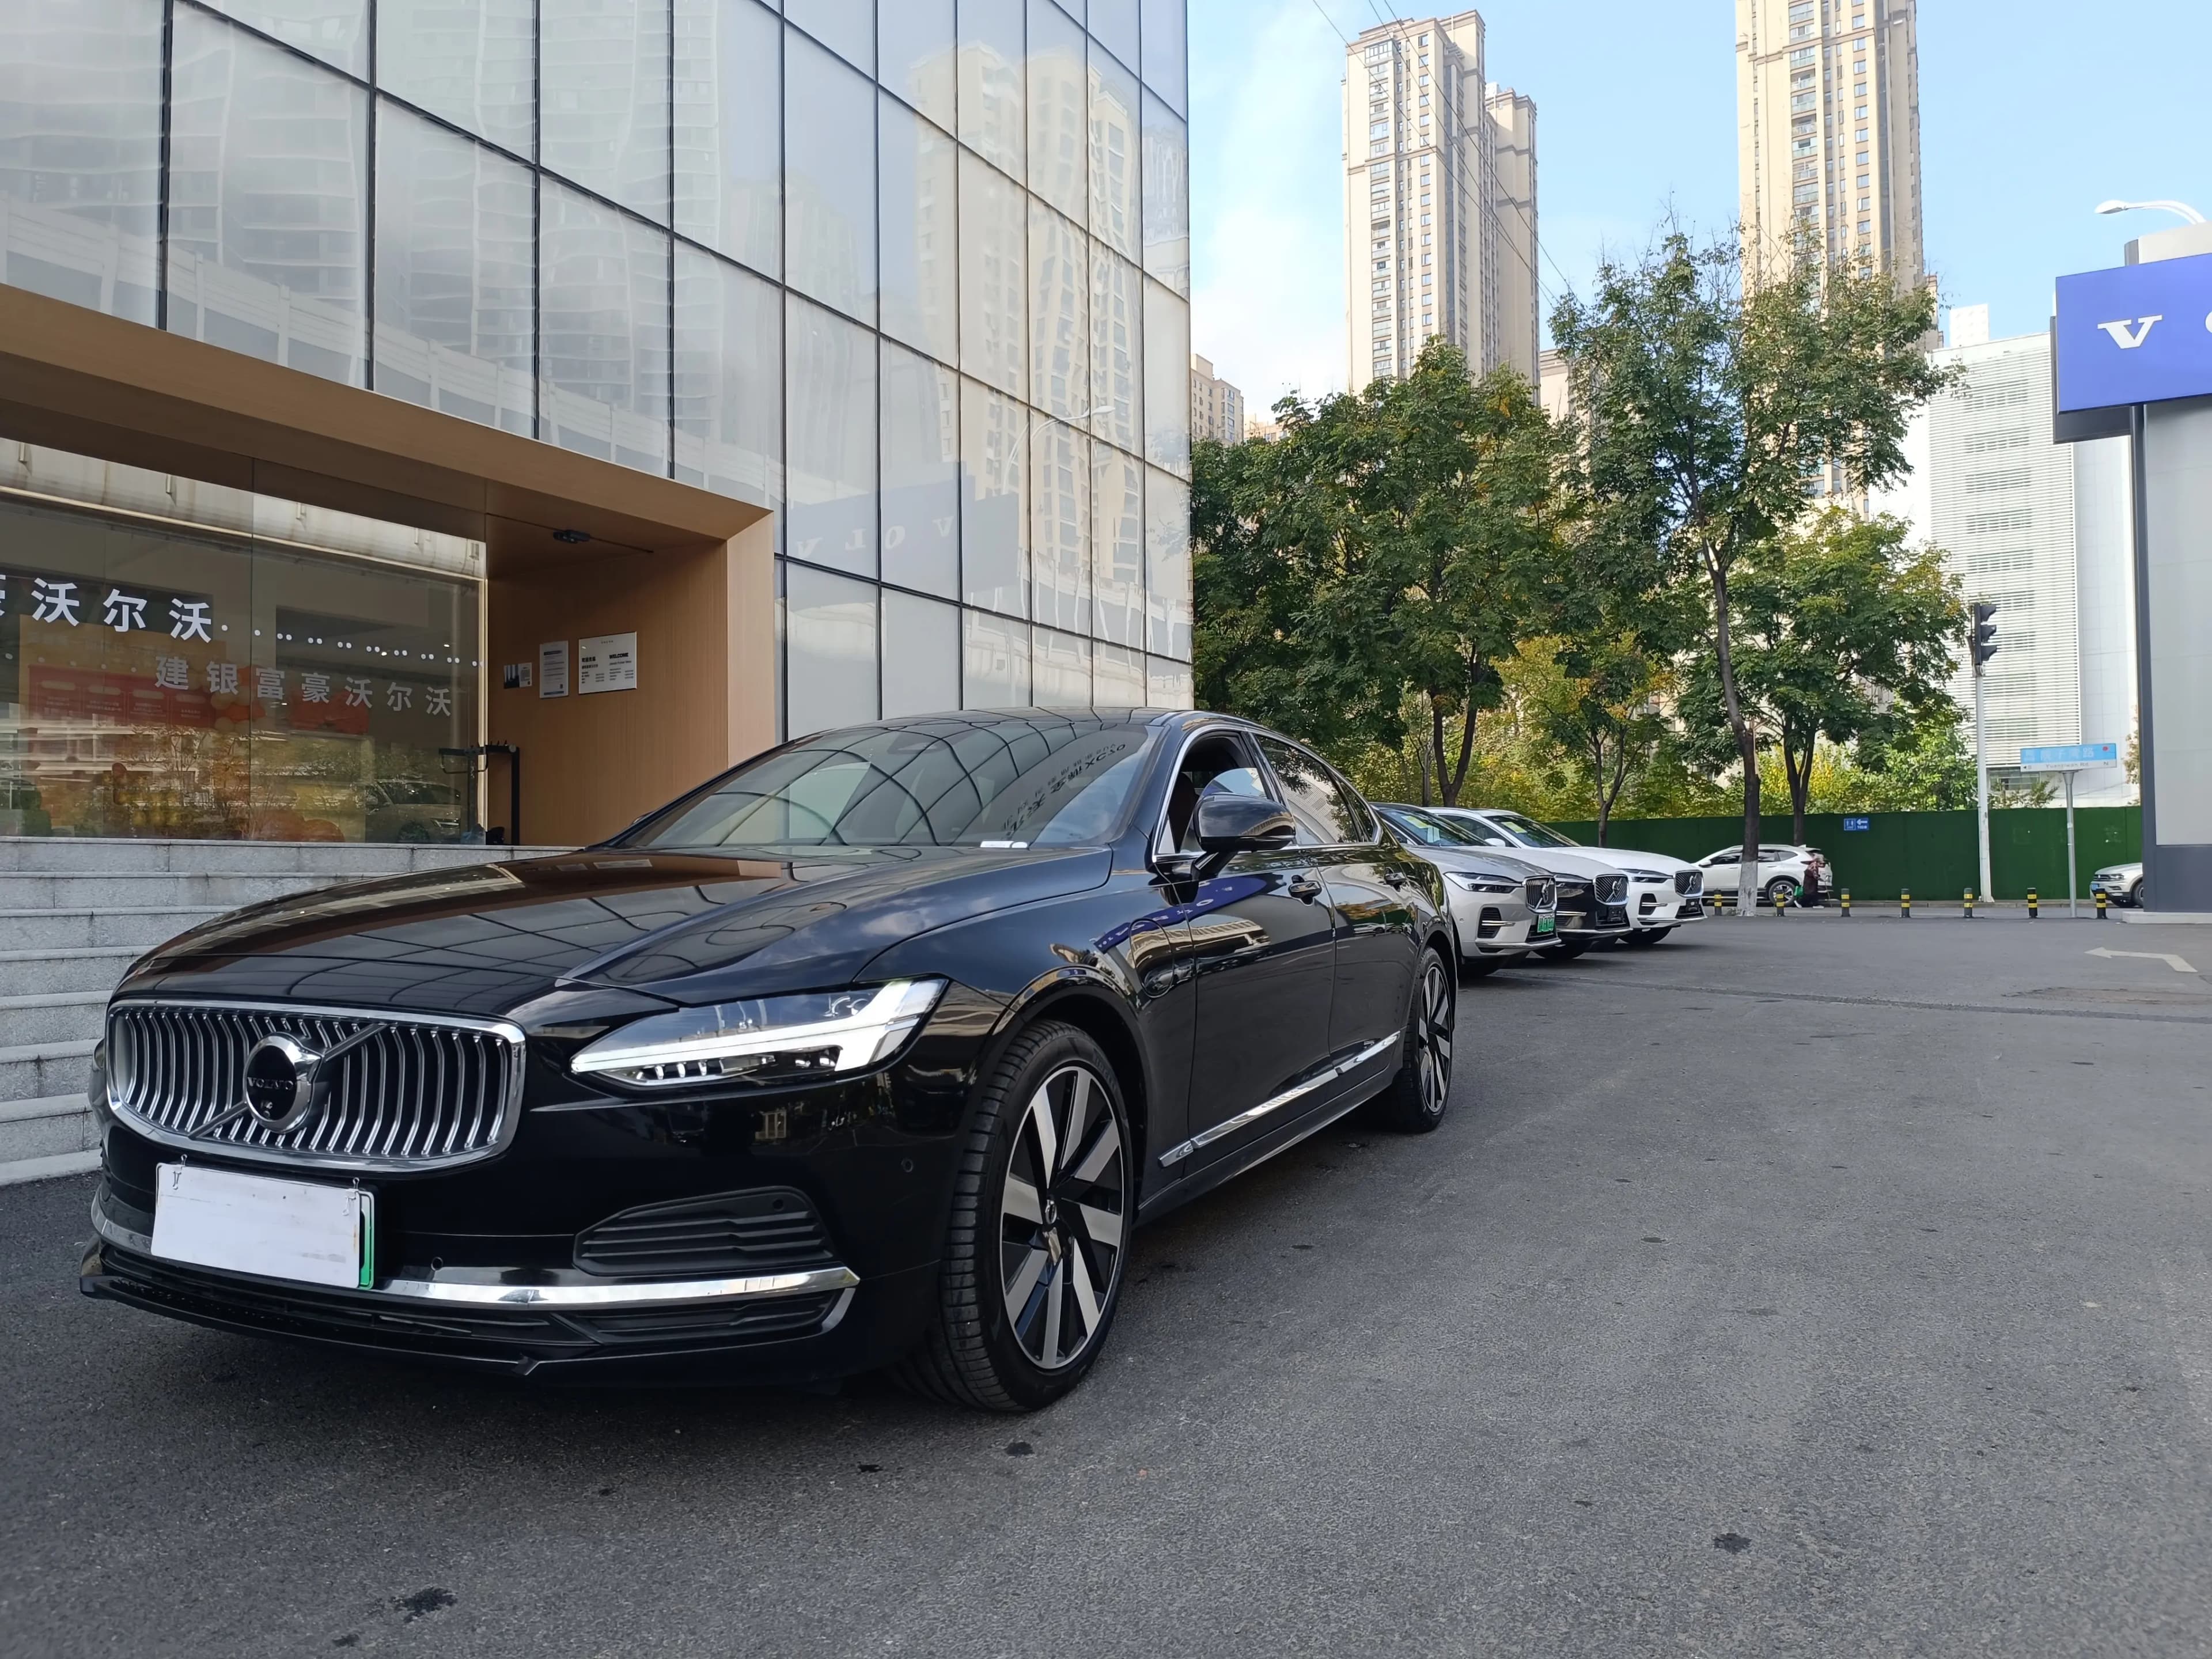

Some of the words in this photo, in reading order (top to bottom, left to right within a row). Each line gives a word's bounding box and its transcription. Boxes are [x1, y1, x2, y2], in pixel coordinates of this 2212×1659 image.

[2096, 310, 2212, 349] V
[0, 574, 211, 643] 沃尔沃
[155, 656, 452, 717] 建银富豪沃尔沃
[247, 1077, 293, 1090] VOLVO
